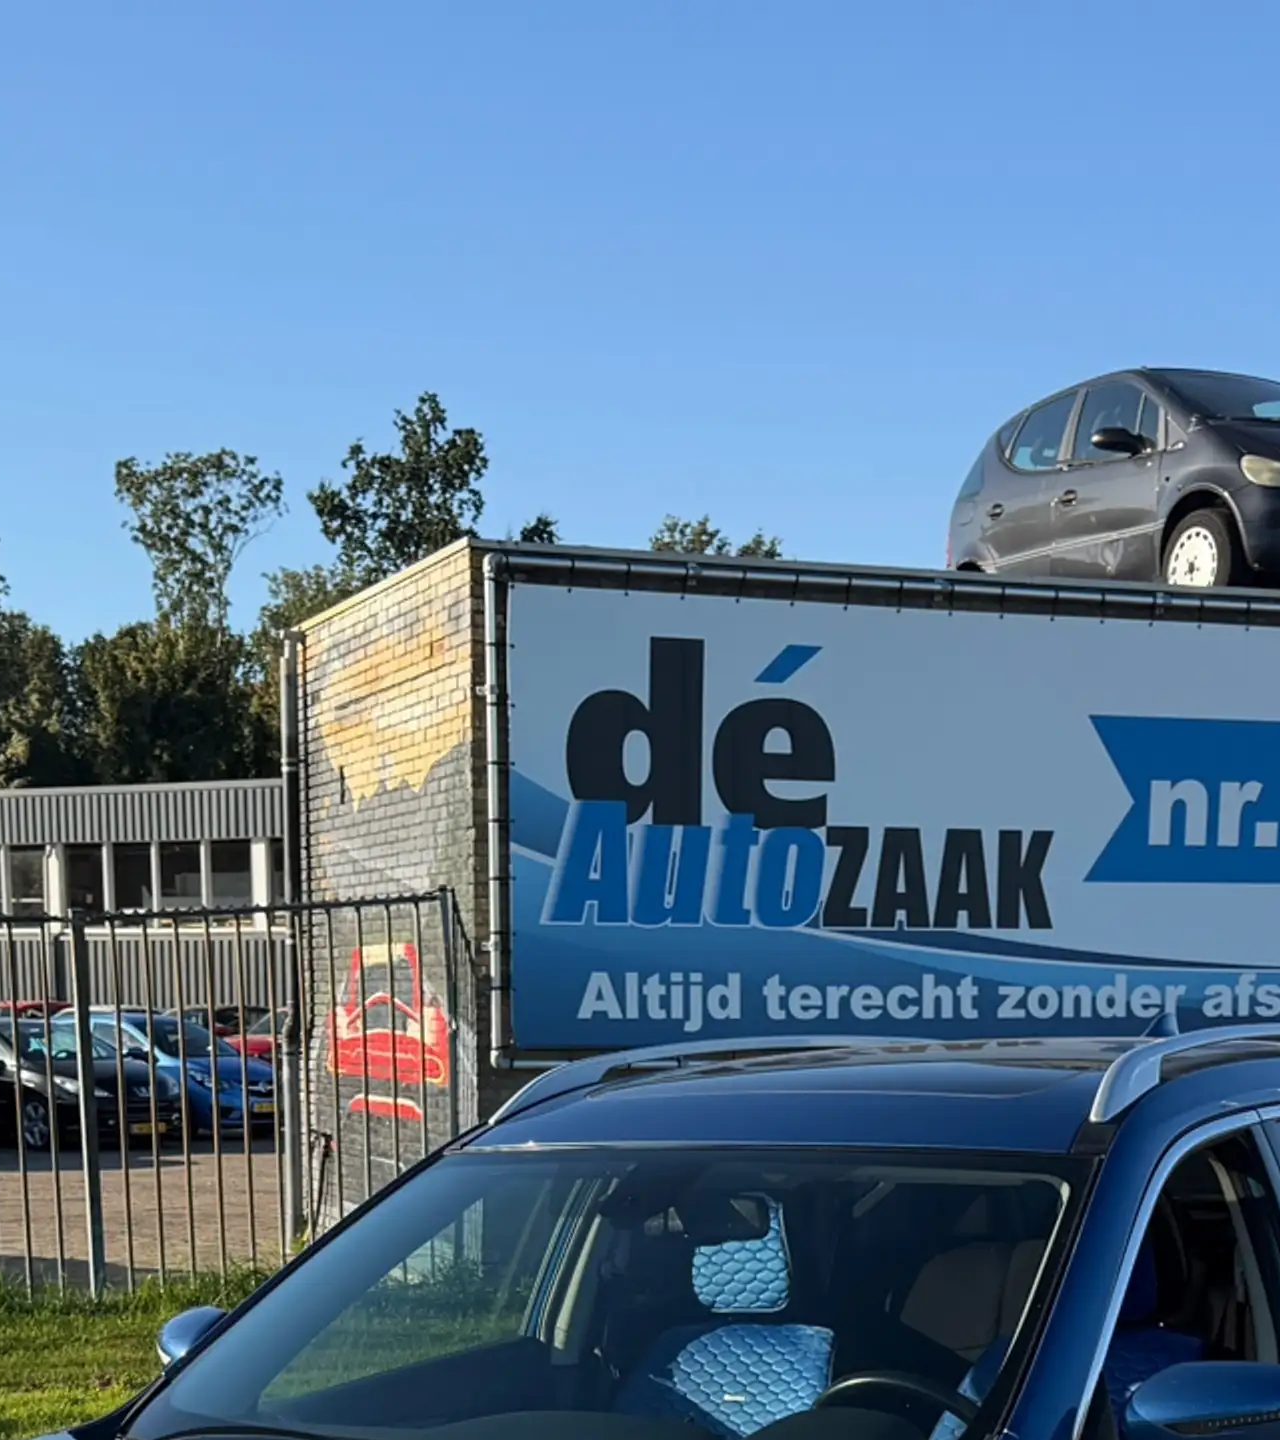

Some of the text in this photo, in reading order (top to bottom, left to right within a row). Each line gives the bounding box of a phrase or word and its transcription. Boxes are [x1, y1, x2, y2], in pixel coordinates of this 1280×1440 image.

[566, 636, 836, 830] dé
[1148, 779, 1279, 848] nr.
[577, 971, 741, 1033] Altijd
[762, 973, 980, 1021] terecht
[996, 973, 1187, 1020] zonder
